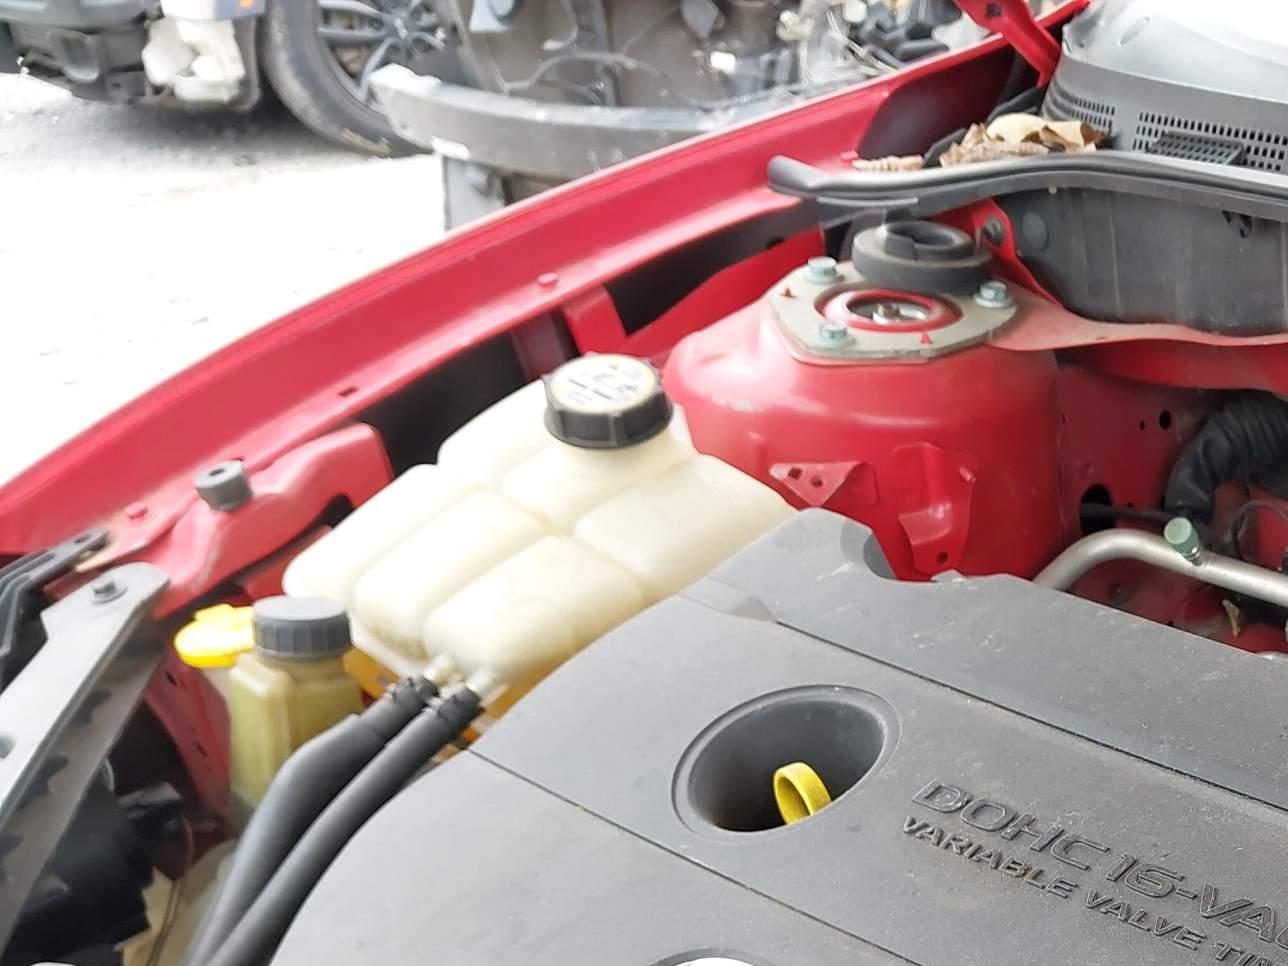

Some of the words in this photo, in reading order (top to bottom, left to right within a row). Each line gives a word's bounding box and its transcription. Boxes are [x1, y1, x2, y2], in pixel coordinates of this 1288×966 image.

[911, 778, 1109, 871] DOHC
[902, 816, 1079, 899] VARIABLE
[1085, 889, 1207, 952] VALVE
